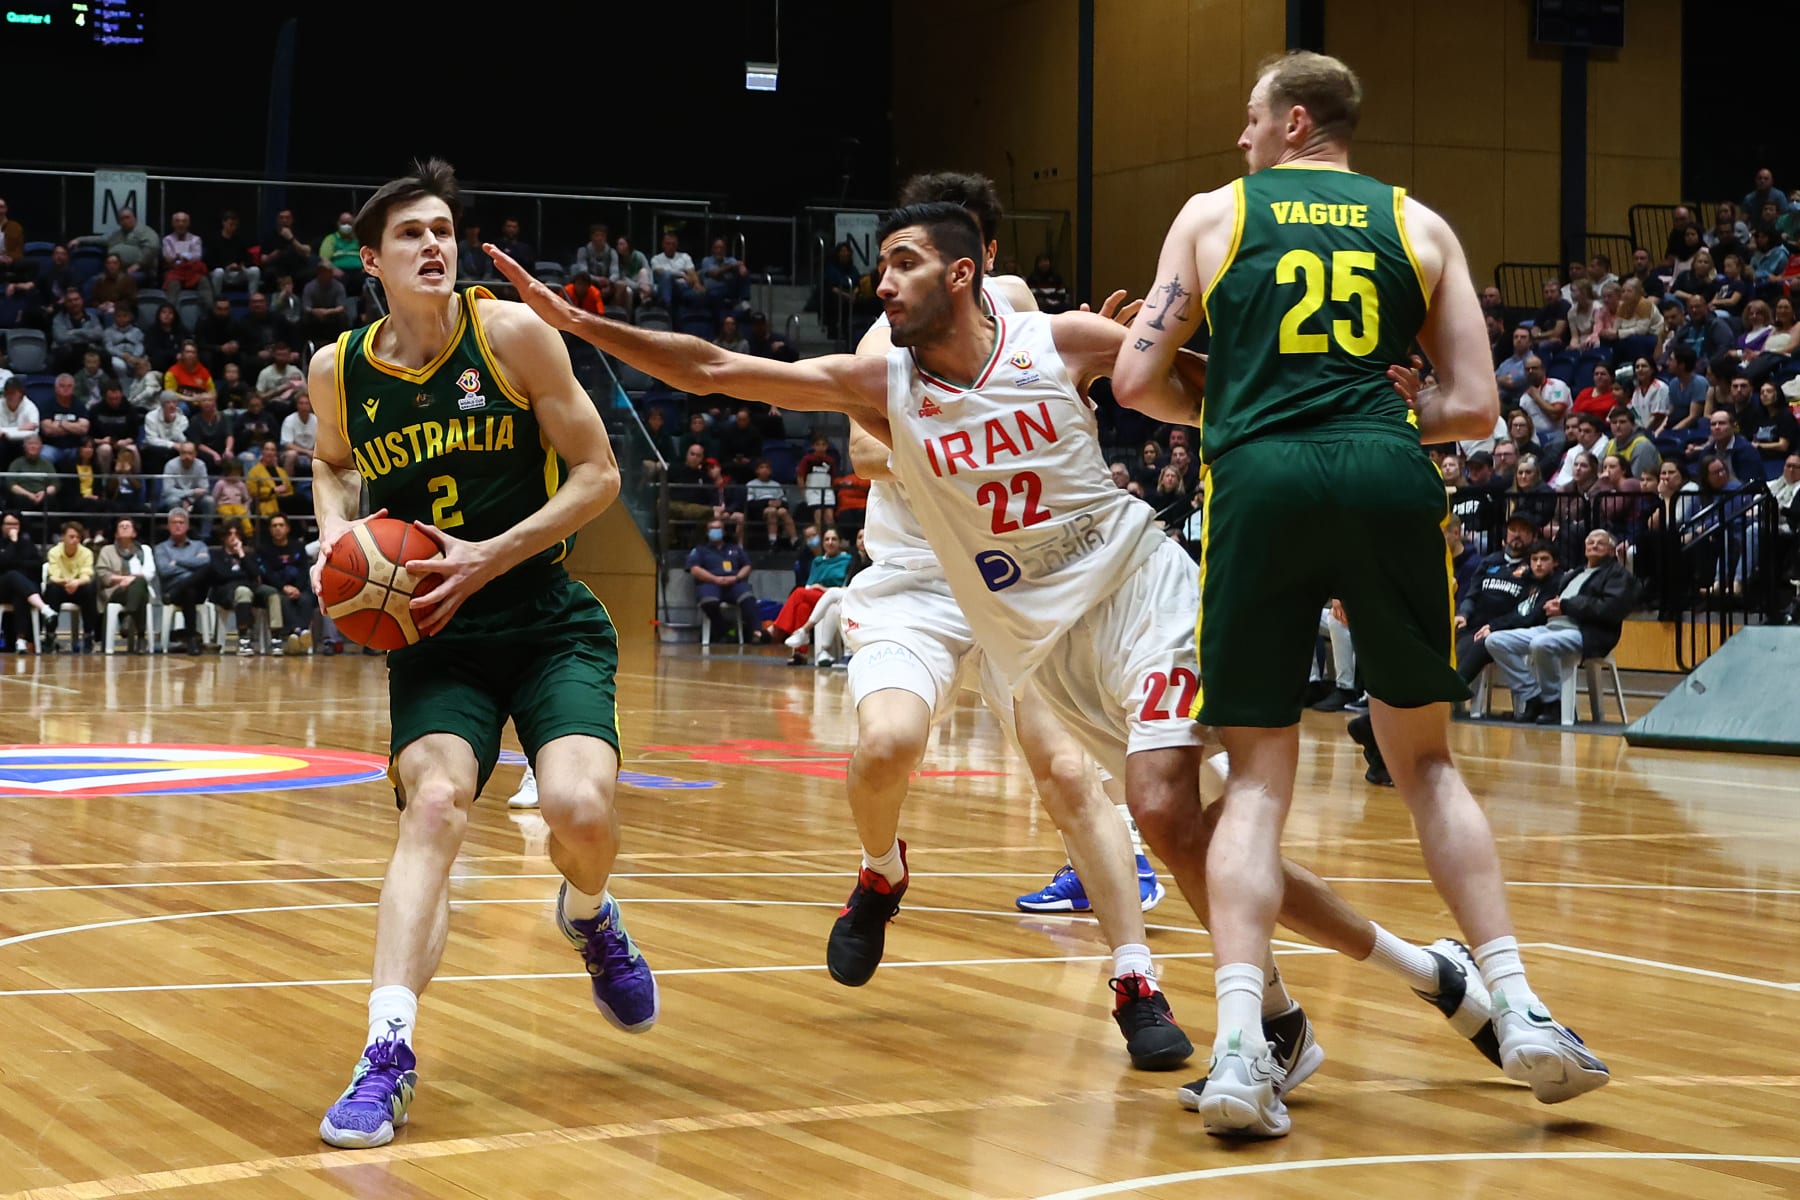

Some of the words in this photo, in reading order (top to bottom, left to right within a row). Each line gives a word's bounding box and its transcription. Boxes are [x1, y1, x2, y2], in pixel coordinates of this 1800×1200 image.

[6, 11, 43, 24] Quarter
[43, 14, 51, 24] 4
[75, 13, 86, 27] 4
[102, 188, 138, 225] M
[1270, 201, 1368, 228] VAGUE
[846, 232, 870, 267] N
[1275, 249, 1380, 357] 25
[1134, 338, 1155, 352] 57
[352, 414, 515, 486] AUSTRALIA
[924, 401, 1058, 478] IRAN
[427, 474, 465, 531] 2
[976, 471, 1052, 535] 22
[1140, 667, 1198, 721] 22
